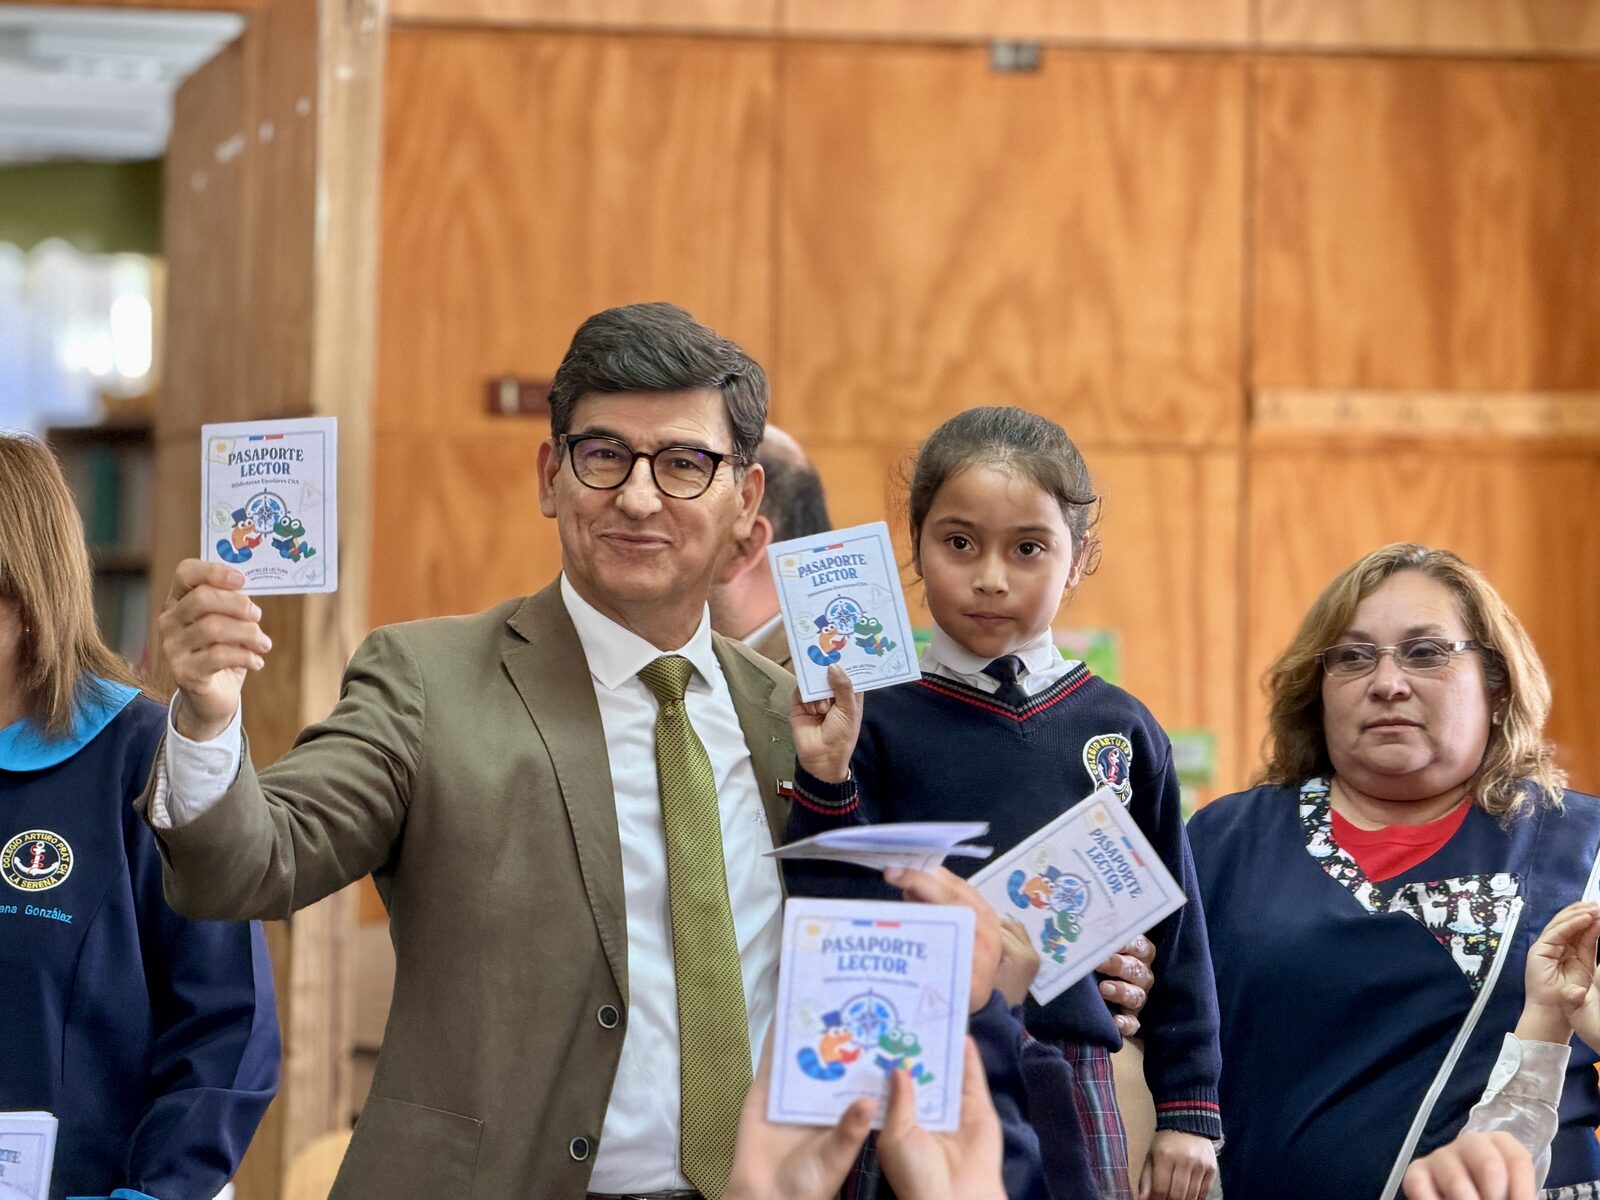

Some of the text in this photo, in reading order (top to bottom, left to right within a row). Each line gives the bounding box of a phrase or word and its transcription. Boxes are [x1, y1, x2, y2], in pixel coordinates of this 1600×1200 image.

[228, 448, 304, 466] PASAPORTE
[240, 462, 290, 477] LECTOR
[798, 554, 867, 578] PASAPORTE
[811, 568, 858, 587] LECTOR
[1099, 737, 1130, 754] ARTURO
[3, 838, 23, 869] COLEGIO
[24, 832, 58, 844] ARTURO
[56, 841, 70, 862] PRAT
[1086, 846, 1124, 895] LECTOR
[1089, 828, 1142, 899] PASAPORTE
[9, 873, 58, 889] LA SERENA
[25, 904, 73, 924] González
[821, 935, 928, 960] PASAPORTE
[837, 953, 908, 975] LECTOR
